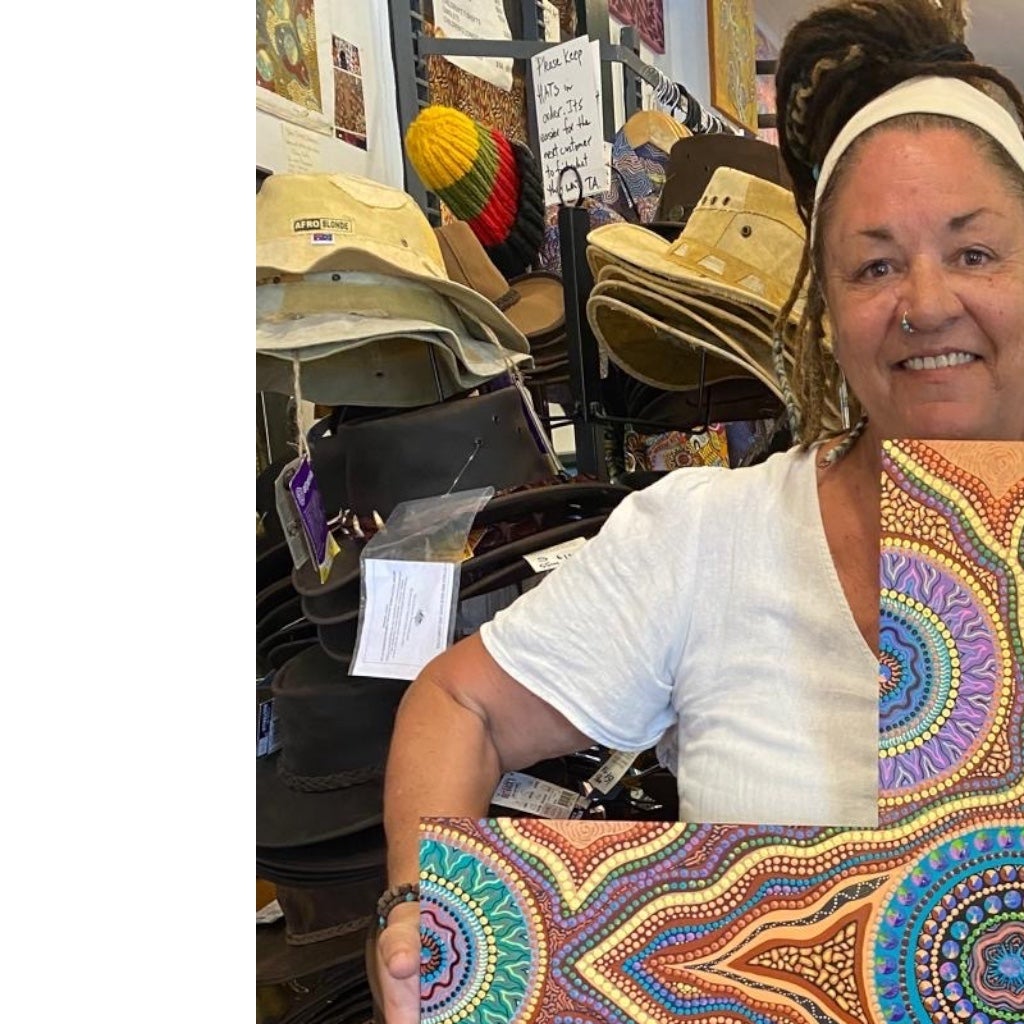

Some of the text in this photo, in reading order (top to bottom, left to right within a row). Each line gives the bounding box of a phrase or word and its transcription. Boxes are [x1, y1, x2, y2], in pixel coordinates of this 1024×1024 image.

[576, 114, 591, 129] the
[295, 220, 349, 231] AFRO BLONDE
